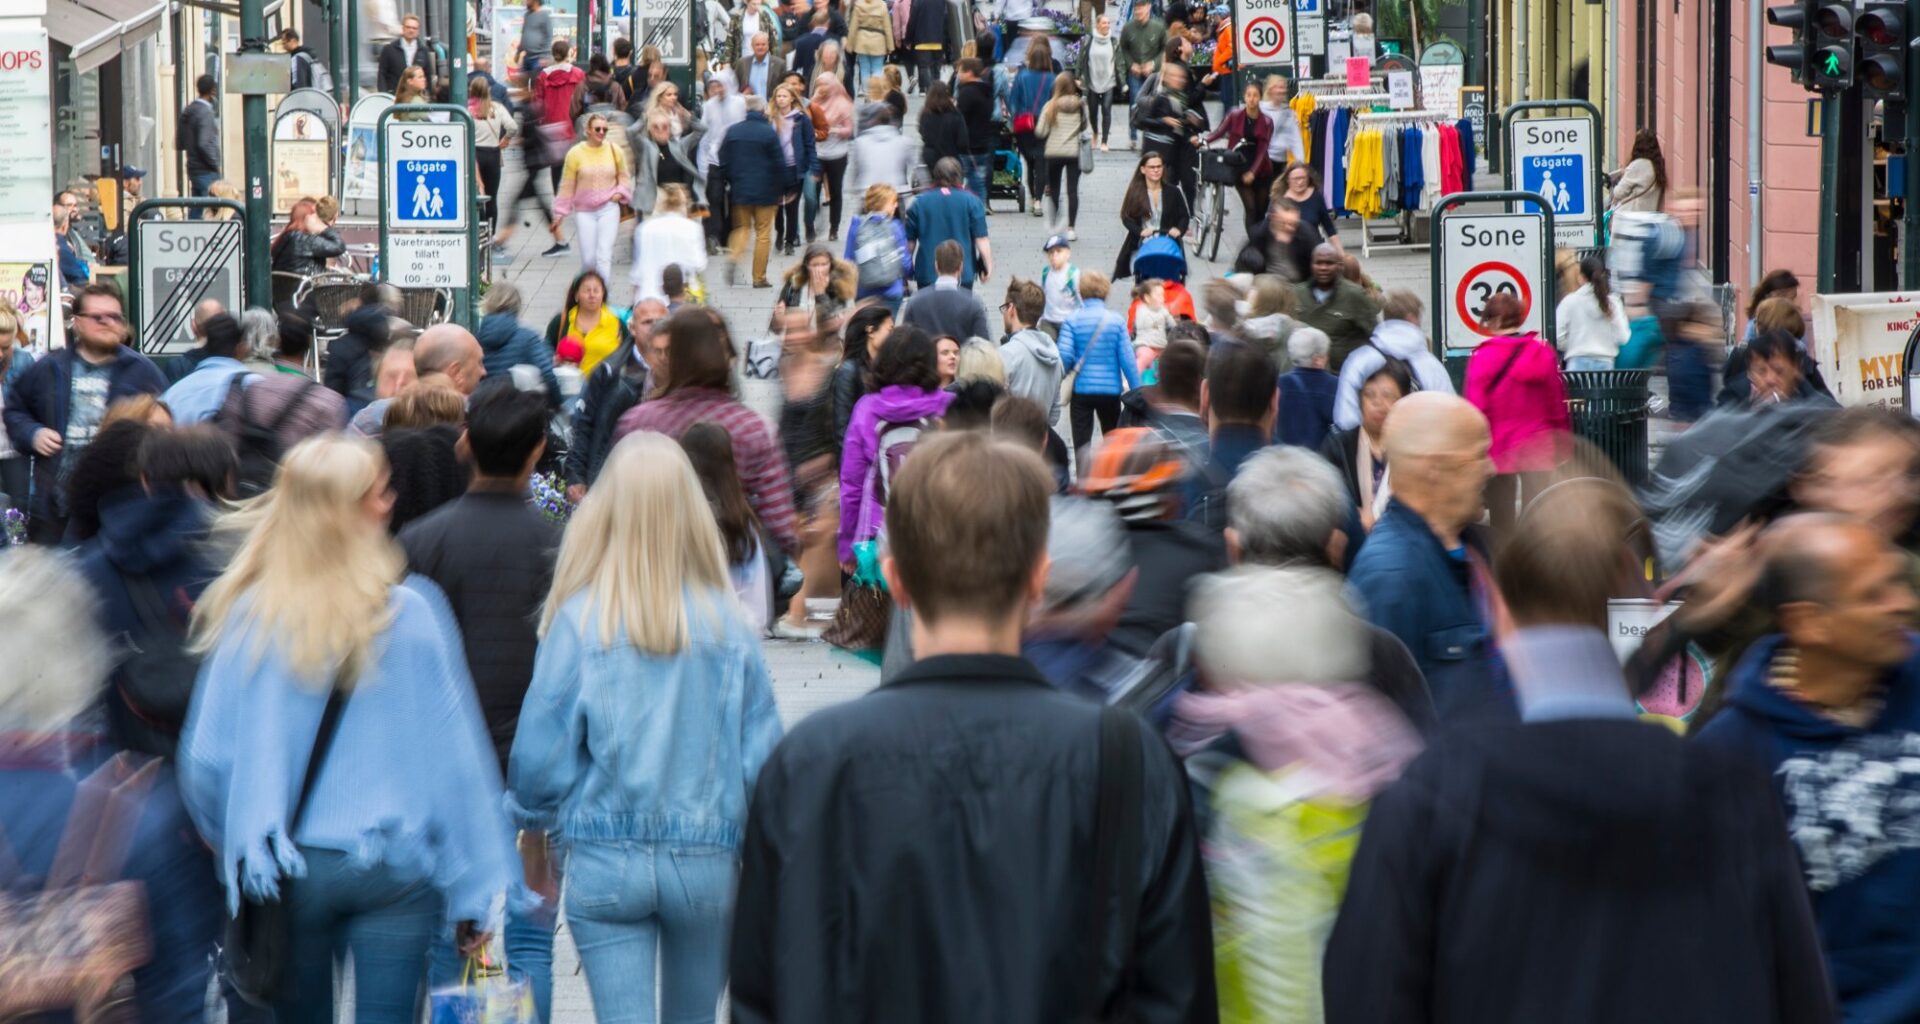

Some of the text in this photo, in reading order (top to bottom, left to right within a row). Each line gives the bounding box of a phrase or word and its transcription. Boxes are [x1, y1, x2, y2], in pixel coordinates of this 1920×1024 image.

[1246, 0, 1281, 9] Sone
[1252, 27, 1278, 47] 30
[0, 50, 42, 70] OPS
[401, 130, 452, 148] Sone
[1527, 127, 1578, 145] Sone
[406, 161, 447, 174] Gågate
[1532, 156, 1573, 170] Gågate
[1461, 224, 1526, 247] Sone
[1554, 230, 1584, 239] nsport
[158, 230, 223, 253] Sone
[394, 238, 461, 248] Varetransport
[415, 250, 439, 258] tillatt
[411, 262, 423, 271] 00
[438, 262, 444, 271] 11
[1887, 321, 1909, 332] KING
[1862, 379, 1884, 392] FOR
